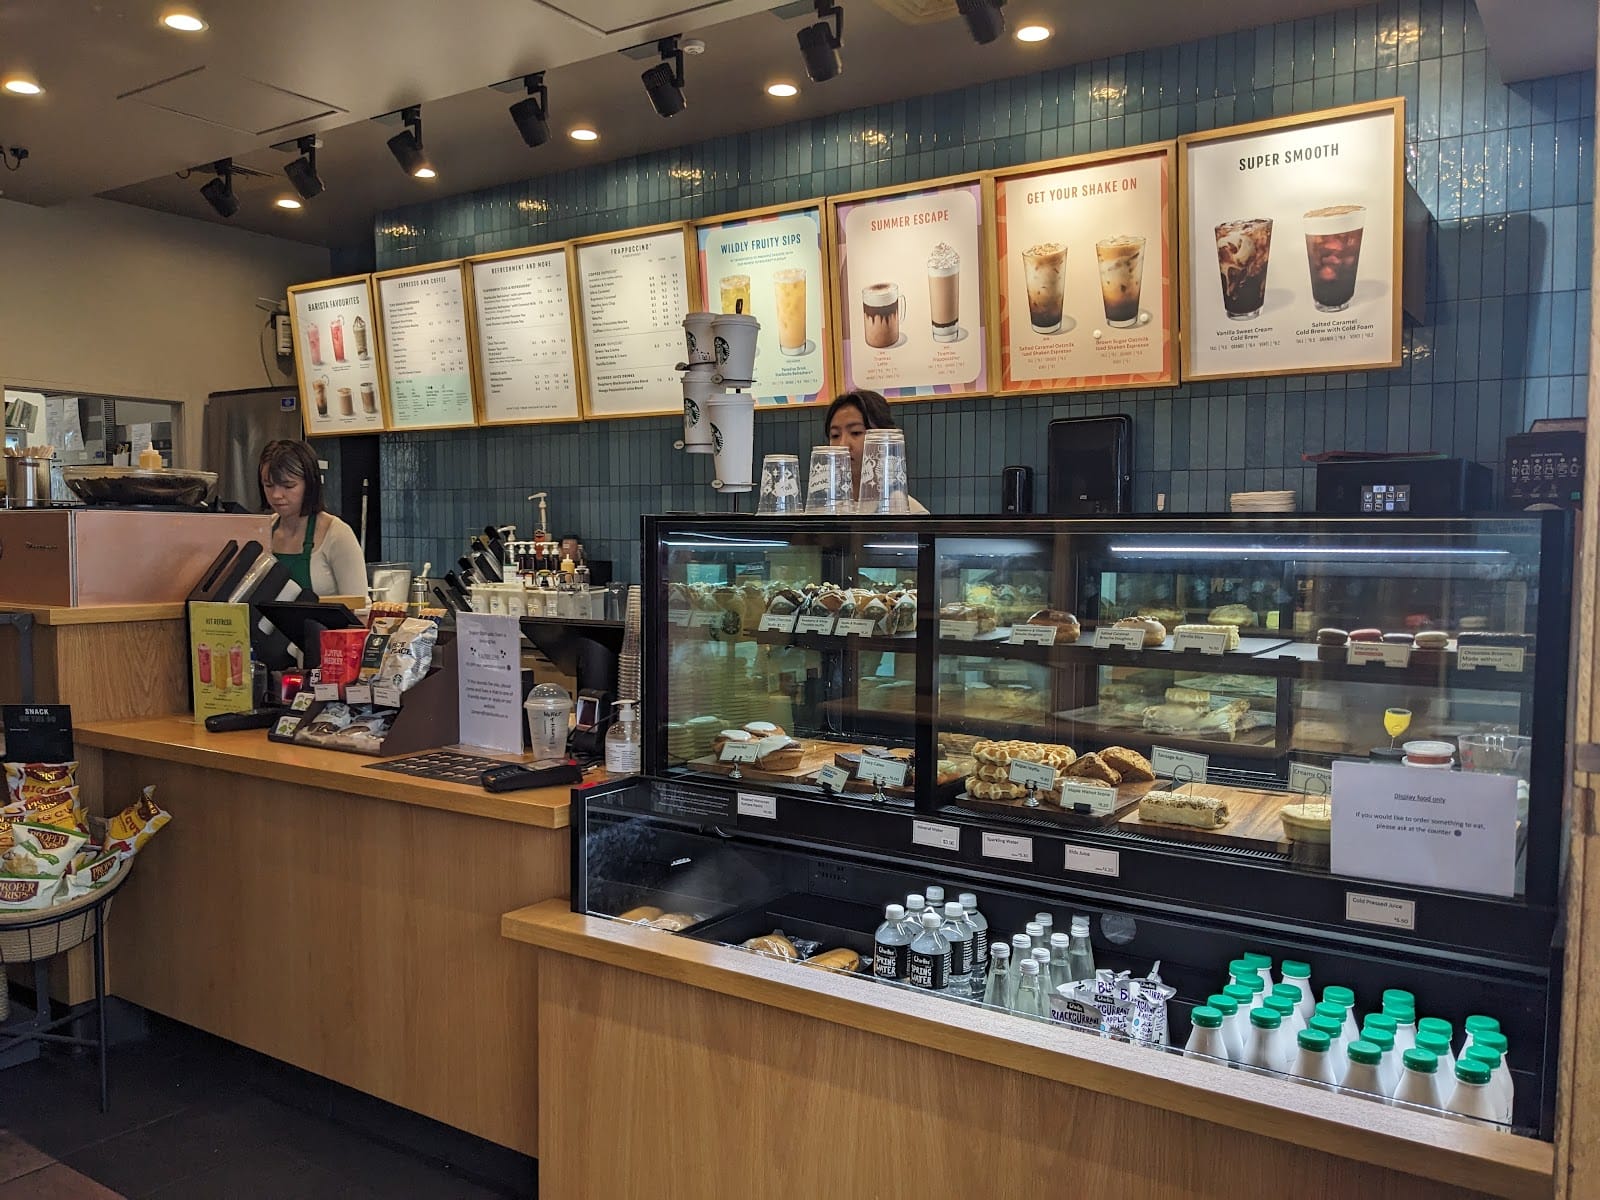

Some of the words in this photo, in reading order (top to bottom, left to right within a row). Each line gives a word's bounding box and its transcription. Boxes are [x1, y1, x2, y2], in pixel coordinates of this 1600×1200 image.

[1239, 152, 1280, 171] SUPER
[1284, 142, 1339, 164] SMOOTH
[1027, 191, 1045, 204] GET
[1050, 186, 1078, 201] YOUR
[1082, 180, 1118, 196] SHAKE
[1122, 177, 1137, 191] ON
[871, 216, 910, 232] SUMMER
[914, 210, 949, 225] ESCAPE
[720, 241, 748, 254] WILDLY
[751, 236, 780, 250] FRUITY
[782, 233, 801, 246] SIPS
[491, 264, 524, 274] REFRESHMENT
[308, 301, 328, 312] BARISTA
[330, 296, 360, 309] FAVOURITES
[1332, 318, 1358, 326] Caramel
[1293, 768, 1314, 778] Creamy
[1394, 793, 1416, 801] Display
[1416, 794, 1431, 803] food
[1431, 818, 1464, 828] something
[1366, 899, 1387, 907] Pressed
[876, 955, 896, 967] SPRING
[876, 964, 896, 976] WATER
[911, 964, 932, 976] SPRING
[911, 974, 932, 986] WATER
[1051, 1010, 1099, 1026] BLACKCURRANT
